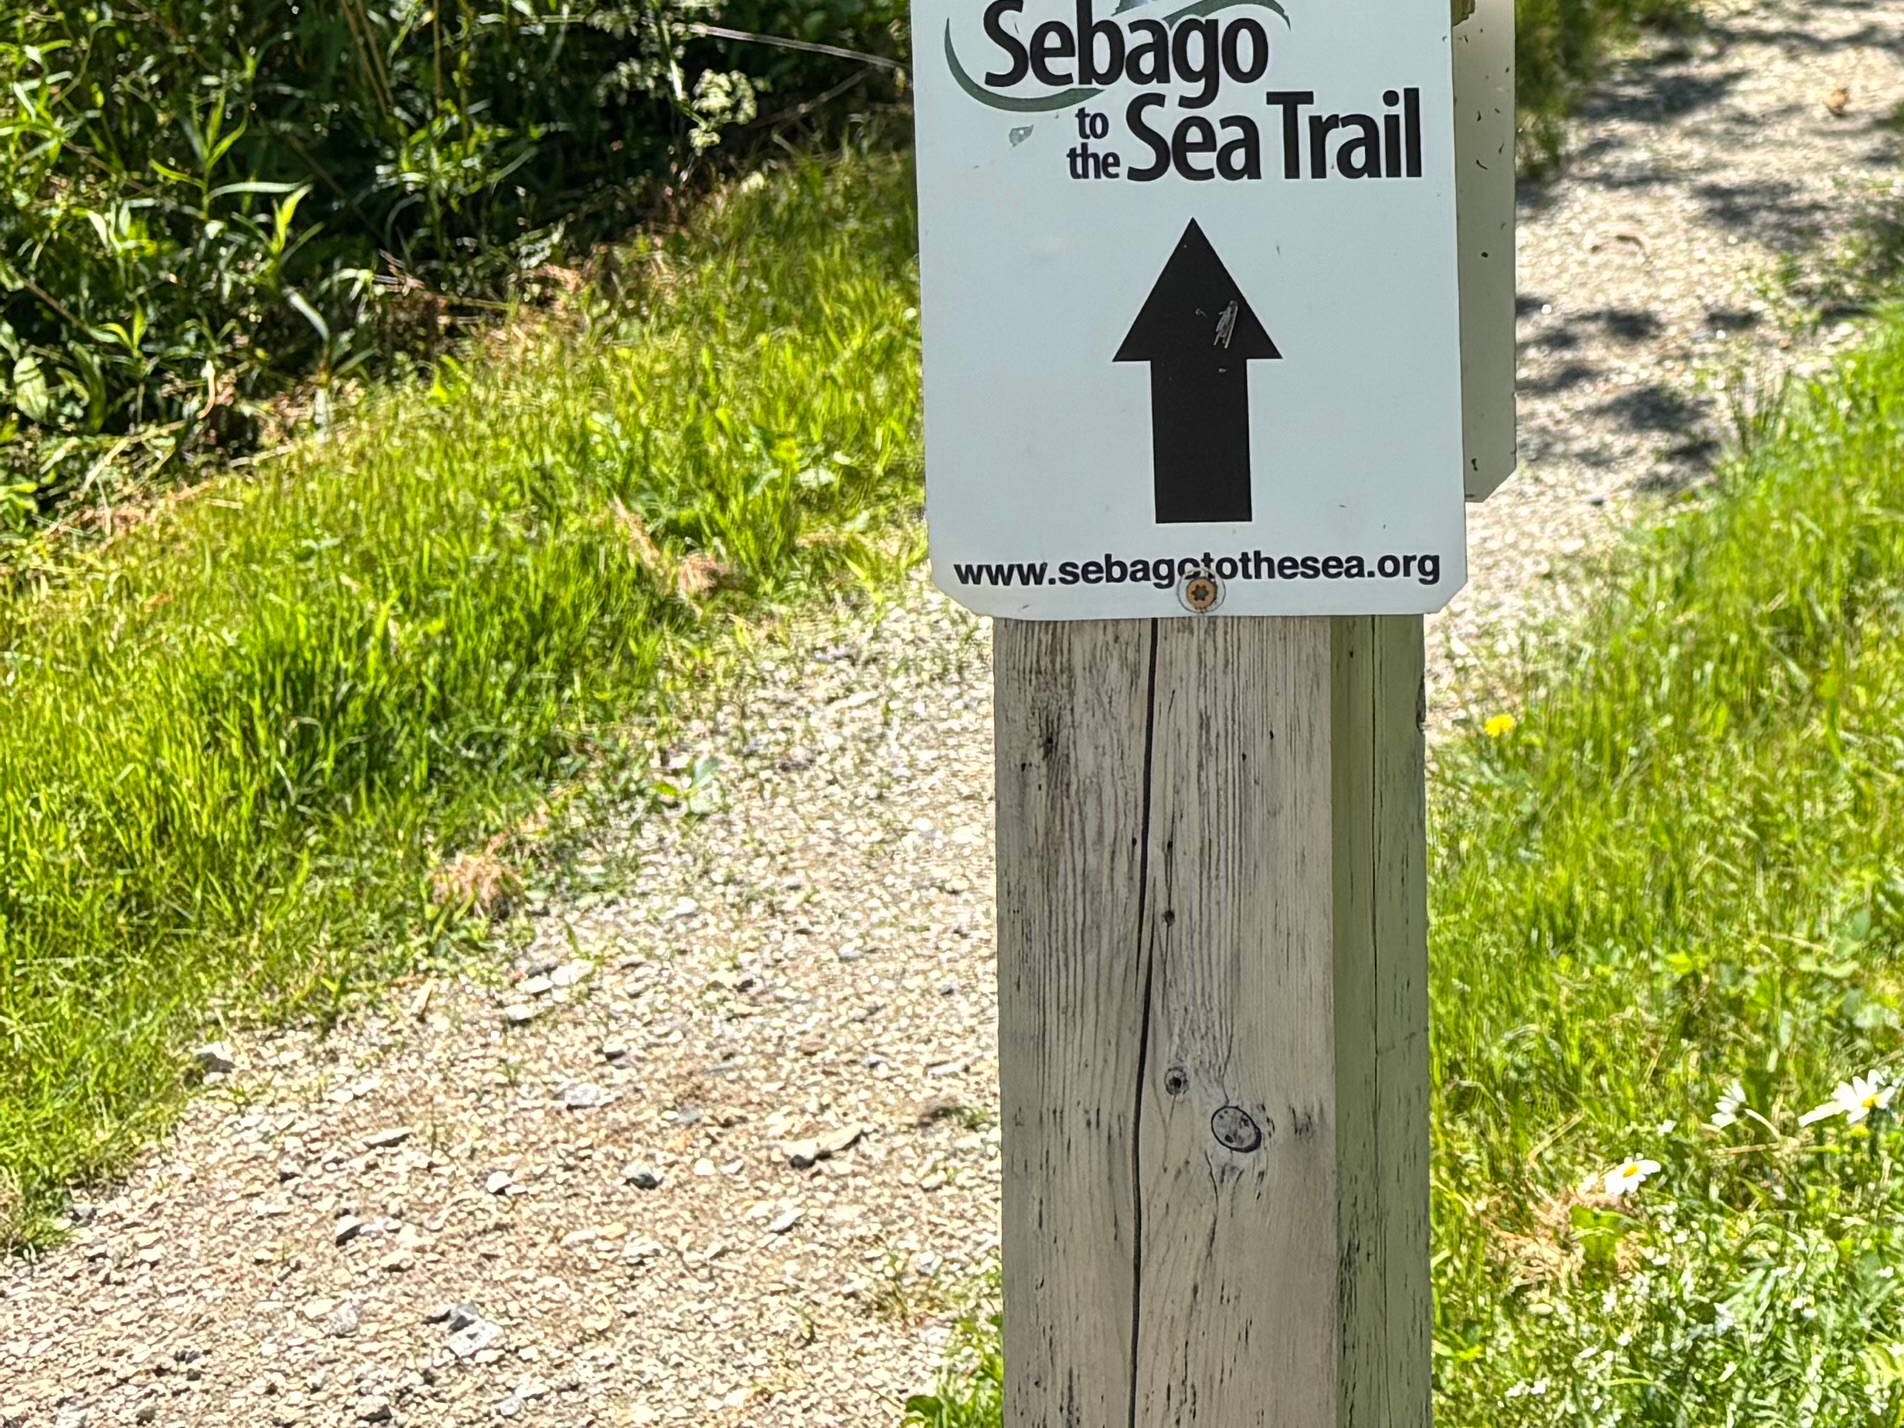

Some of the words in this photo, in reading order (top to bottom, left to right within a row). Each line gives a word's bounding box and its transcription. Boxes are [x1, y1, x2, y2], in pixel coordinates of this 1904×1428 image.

[1067, 142, 1121, 181] the
[1125, 92, 1262, 182] Sea
[1266, 87, 1423, 180] Trail
[1076, 107, 1109, 140] to
[953, 551, 1441, 590] www.sebagotothesea.org
